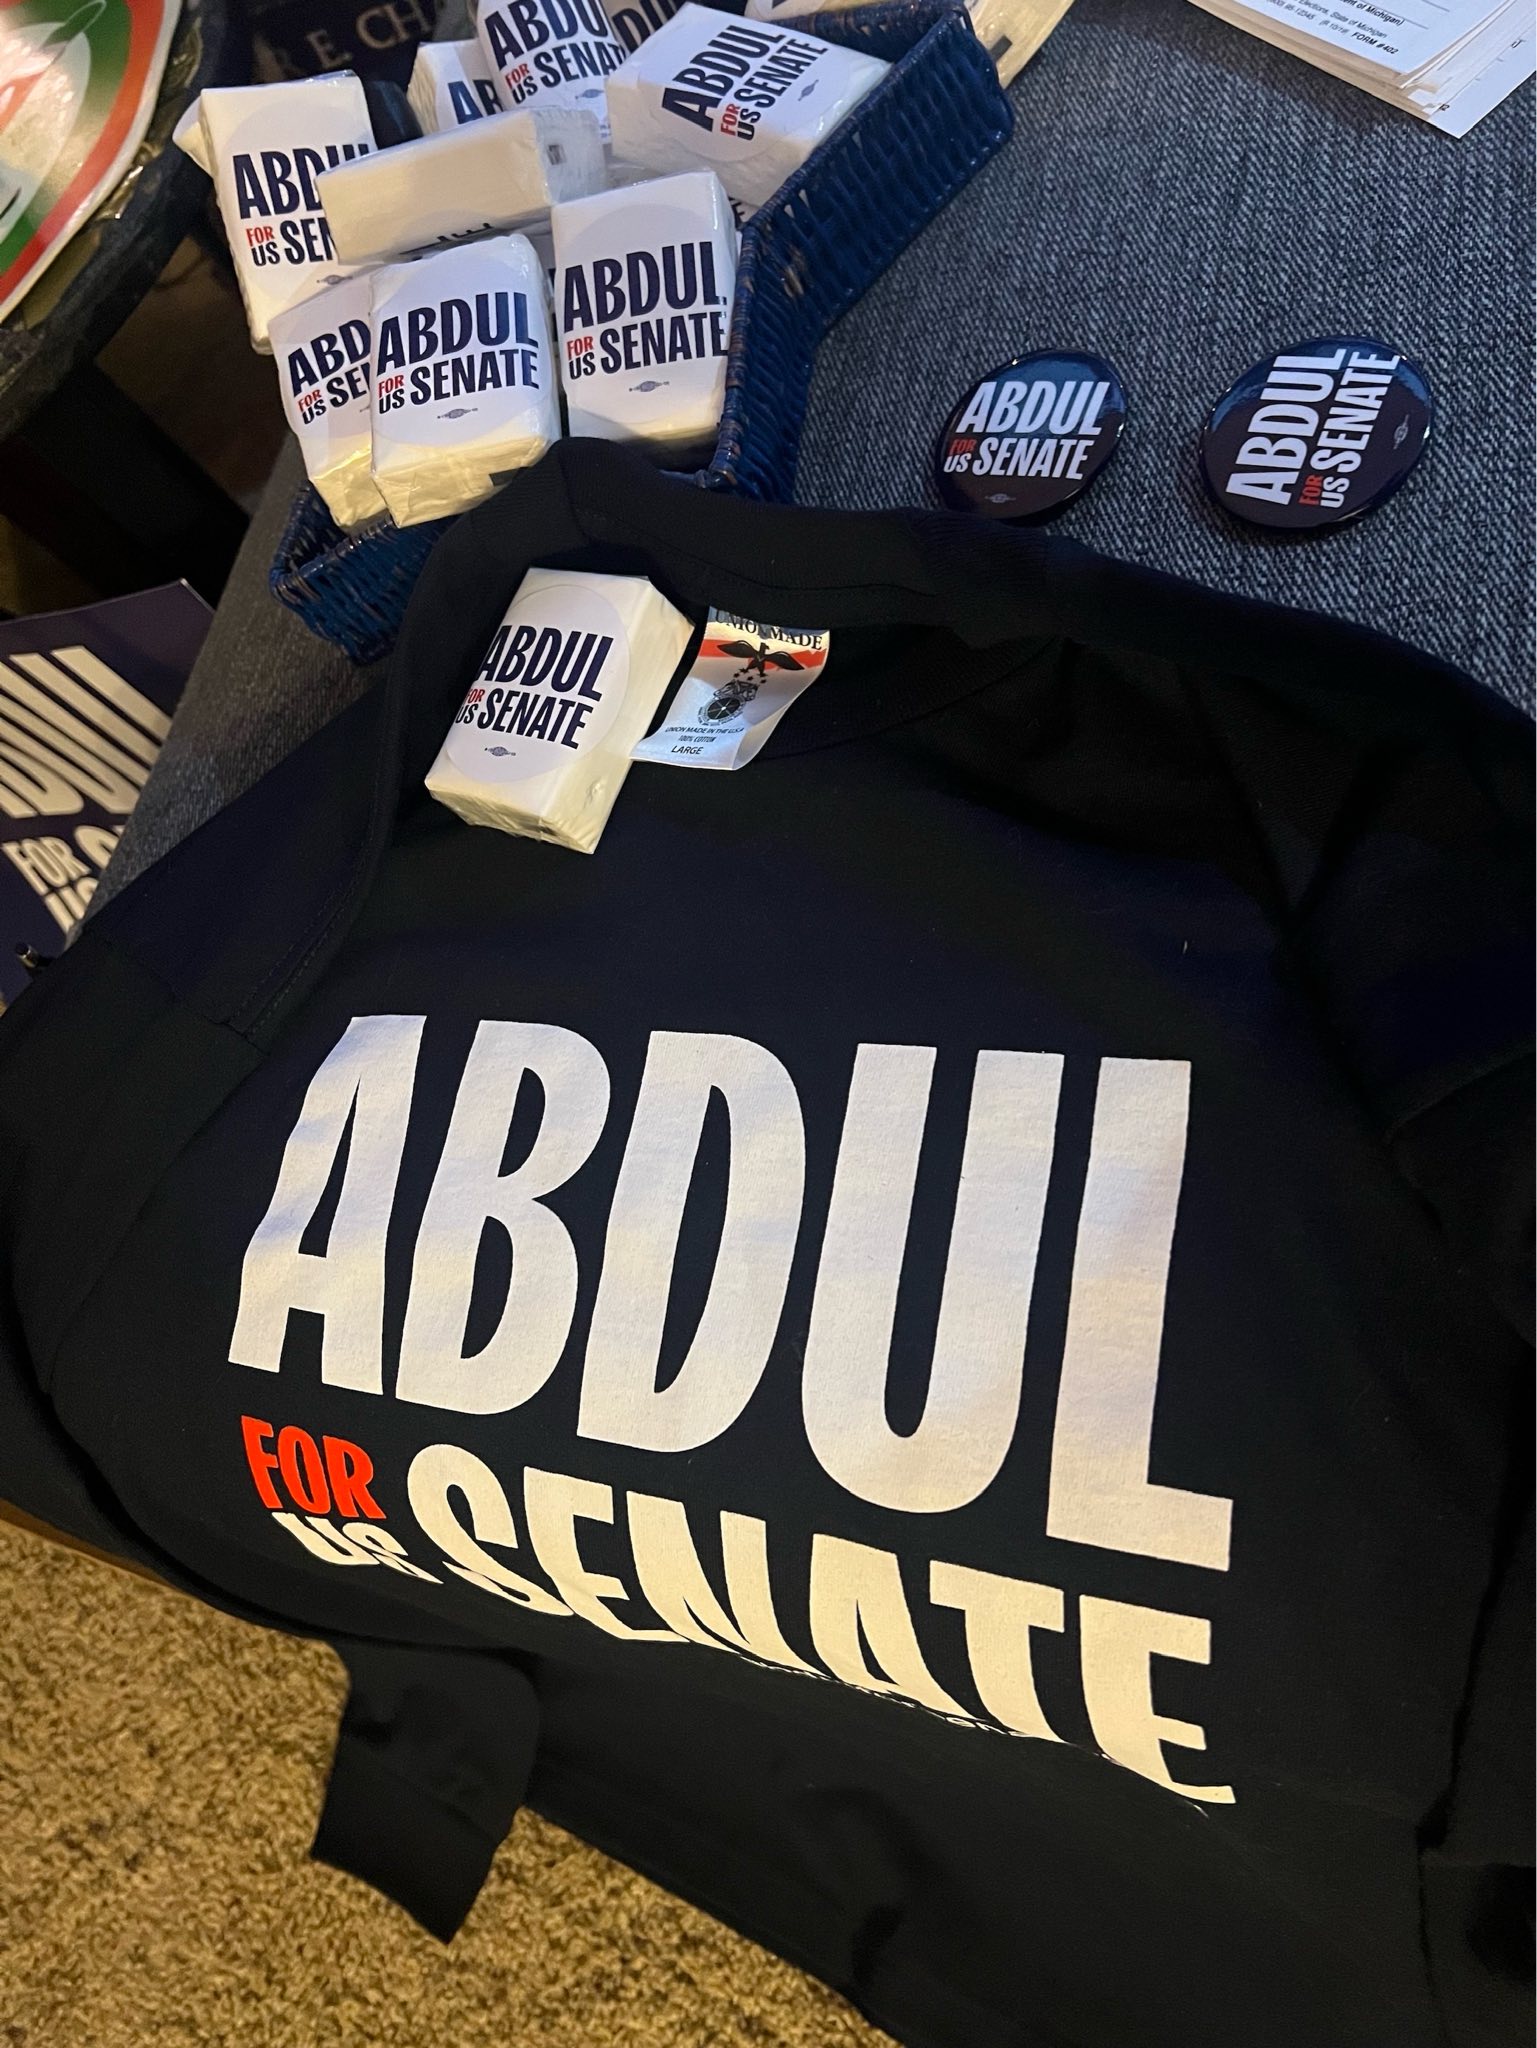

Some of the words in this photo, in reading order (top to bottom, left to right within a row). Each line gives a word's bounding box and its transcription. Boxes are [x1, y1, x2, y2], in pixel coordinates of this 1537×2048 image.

[1365, 5, 1405, 27] Michigan)
[1351, 31, 1378, 45] FORM
[1375, 43, 1399, 55] #402
[505, 63, 530, 90] FOR
[511, 76, 539, 104] US
[534, 41, 627, 88] SENAT
[661, 24, 787, 132] ABDUL
[733, 38, 829, 109] SENATE
[720, 103, 741, 136] FOR
[737, 108, 762, 141] US
[232, 144, 370, 220] ABD
[246, 225, 275, 248] FOR
[251, 240, 281, 267] US
[564, 241, 728, 334] ABDUL
[377, 291, 539, 377] ABDUL
[566, 336, 594, 361] FOR
[569, 351, 596, 380] US
[599, 311, 728, 374] SENATE
[298, 389, 321, 413] FOR
[378, 374, 405, 400] FOR
[379, 388, 406, 415] US
[410, 348, 540, 405] SENATE
[302, 398, 327, 424] US
[955, 380, 1111, 436] ABDUL
[1225, 348, 1347, 505] ABDUL
[1310, 351, 1401, 473] SENATE
[943, 452, 972, 473] US
[972, 436, 1095, 480] SENATE
[949, 438, 977, 454] FOR
[1299, 474, 1324, 506] FOR
[1320, 475, 1351, 509] US
[476, 625, 614, 702] ABDUL
[770, 626, 823, 651] MADE
[477, 688, 594, 750] SENATE
[671, 745, 704, 755] LARGE
[2, 836, 91, 896] FOR
[229, 1015, 1233, 1571] ABDUL
[241, 1415, 387, 1519] FOR
[271, 1512, 444, 1584] US
[407, 1444, 1236, 1804] SENATE
